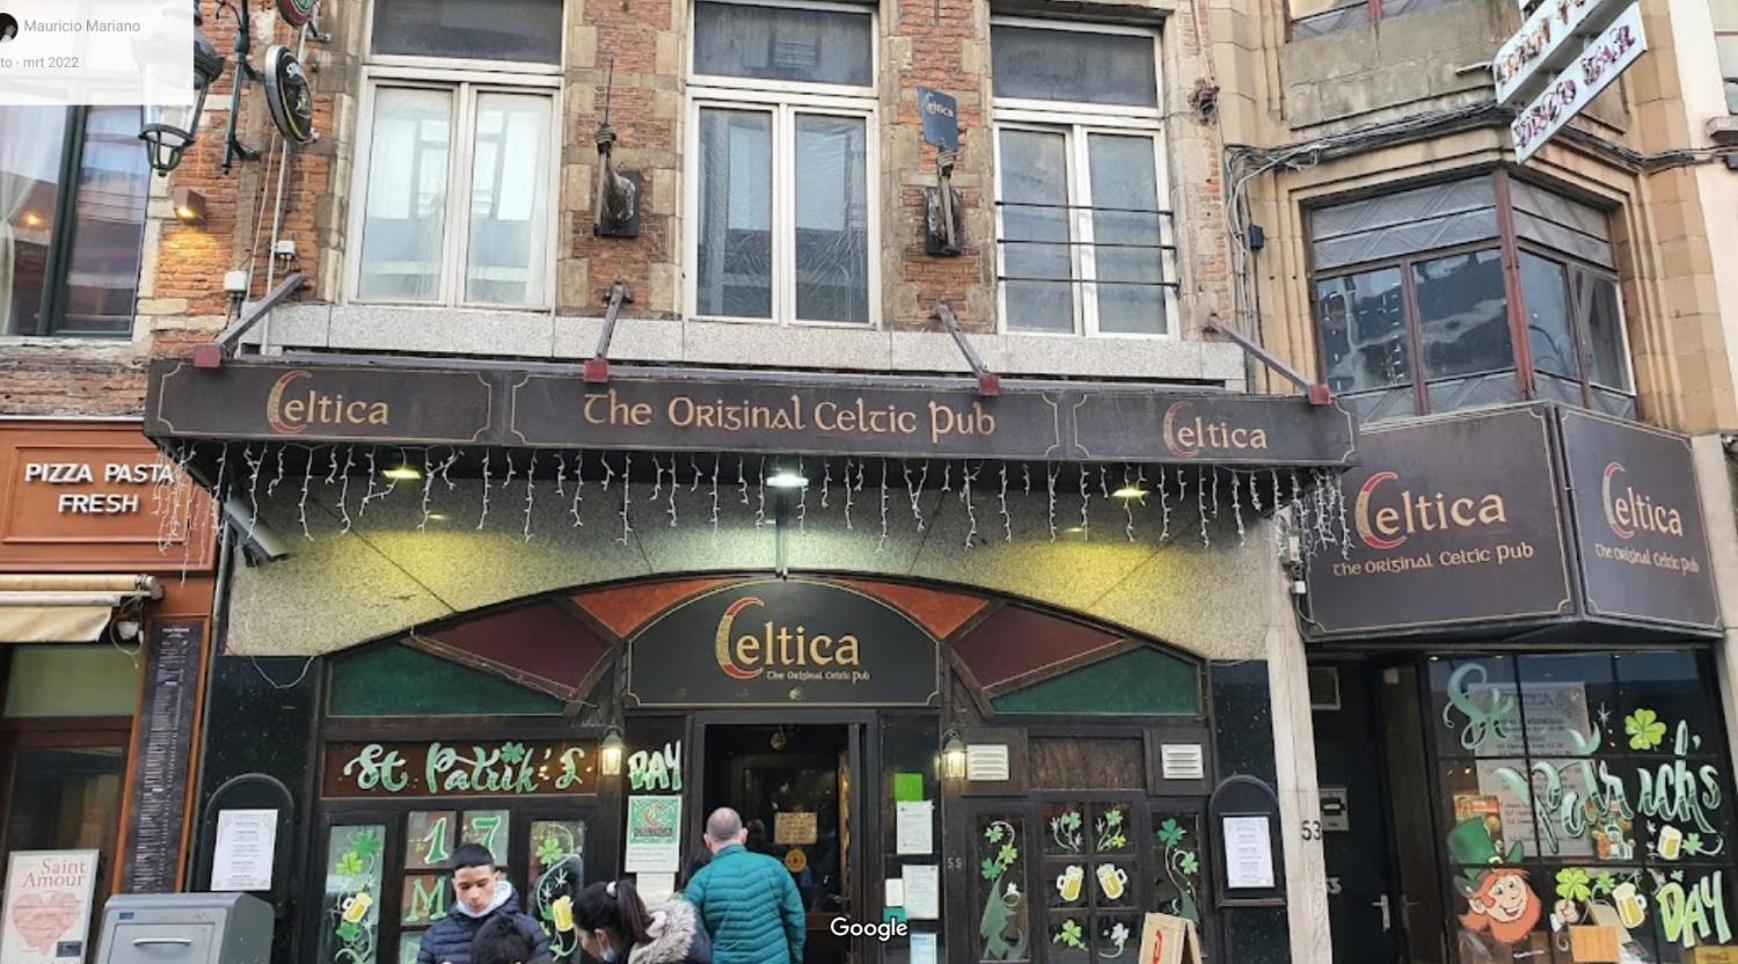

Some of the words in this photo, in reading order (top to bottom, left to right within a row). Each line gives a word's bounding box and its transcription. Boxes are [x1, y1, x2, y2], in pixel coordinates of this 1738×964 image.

[266, 370, 390, 434] Celtica
[584, 387, 653, 426] The
[668, 394, 807, 431] Original
[814, 397, 918, 434] Celtic
[928, 400, 997, 444] Pub
[1163, 400, 1268, 458] Celtica
[25, 463, 94, 483] PIZZA
[104, 463, 175, 483] PASTA
[57, 494, 140, 514] FRESH
[1355, 471, 1508, 550] Celtica
[1602, 461, 1684, 539] Celtica
[1440, 548, 1490, 567] Celtic
[716, 597, 860, 680] Celtica
[1302, 820, 1321, 841] 53
[22, 873, 86, 888] Amour
[41, 857, 86, 875] Saint
